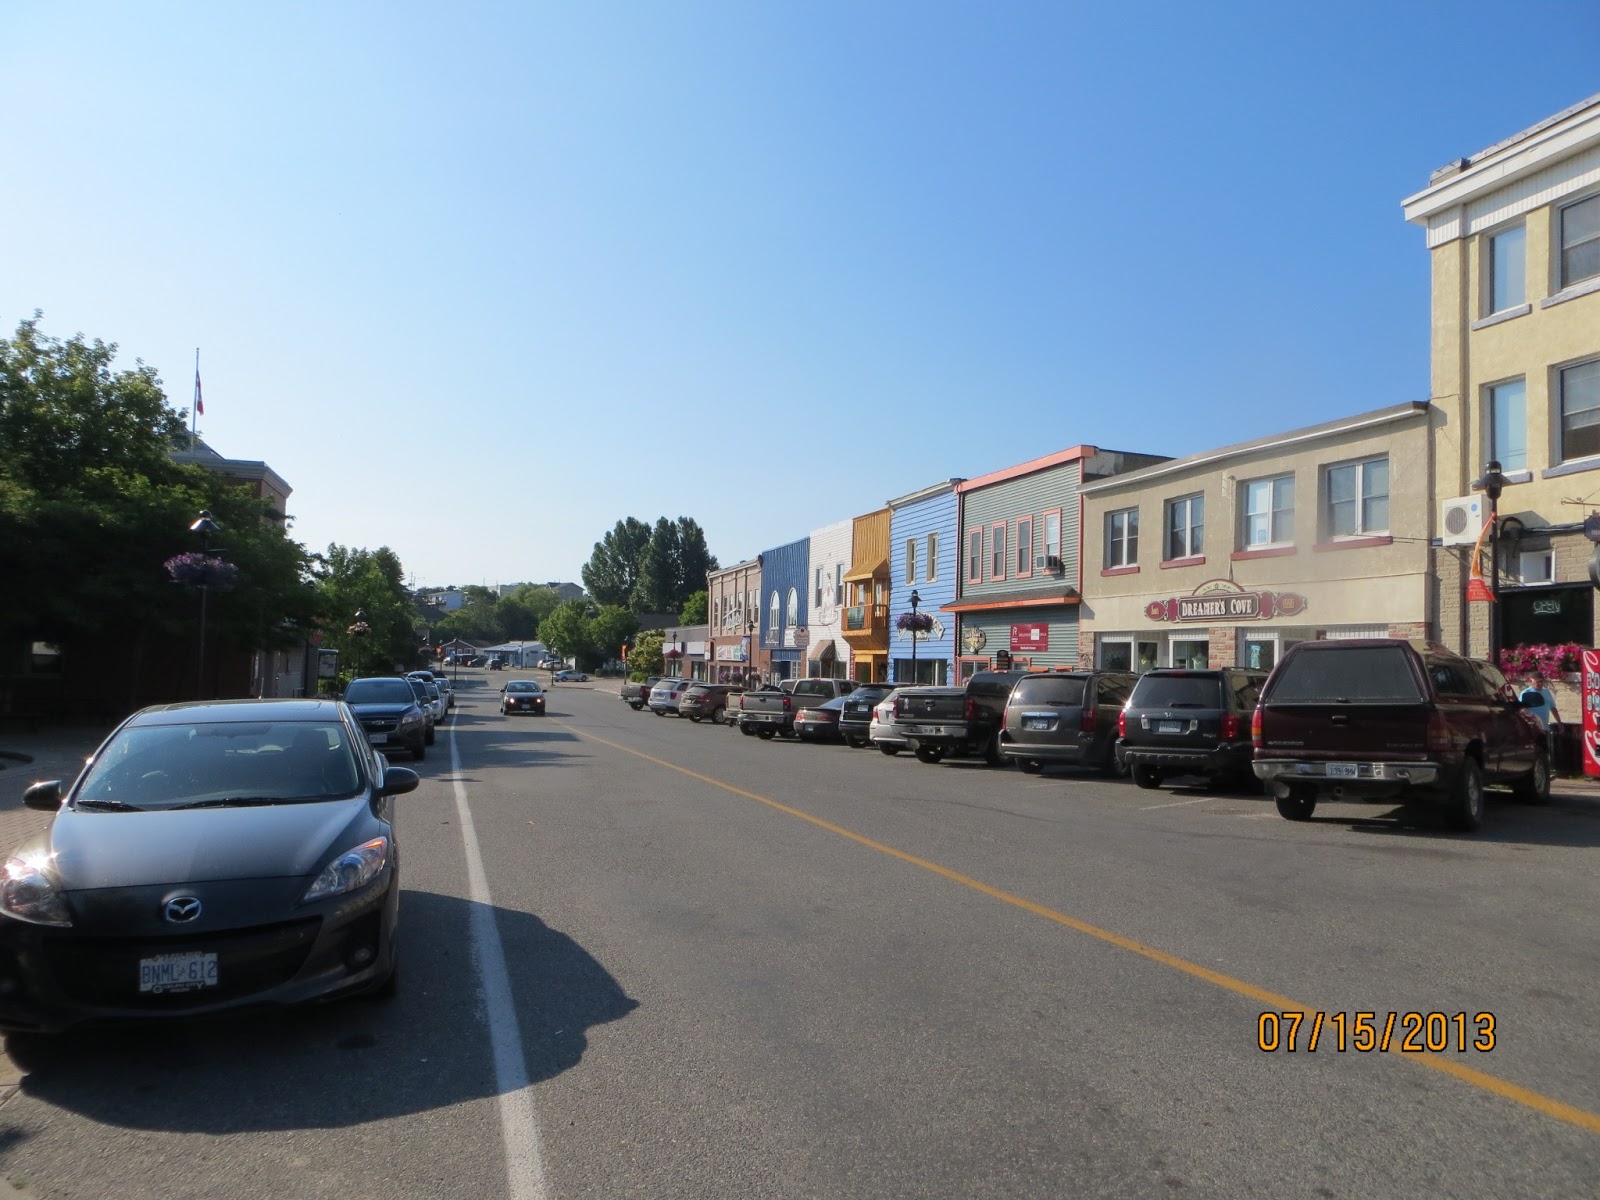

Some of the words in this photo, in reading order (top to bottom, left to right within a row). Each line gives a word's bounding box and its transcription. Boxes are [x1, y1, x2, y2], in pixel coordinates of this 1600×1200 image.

[1182, 599, 1225, 617] DREAMER'S
[1231, 599, 1252, 614] COVE
[1533, 600, 1561, 613] OPEN
[188, 961, 217, 980] 612
